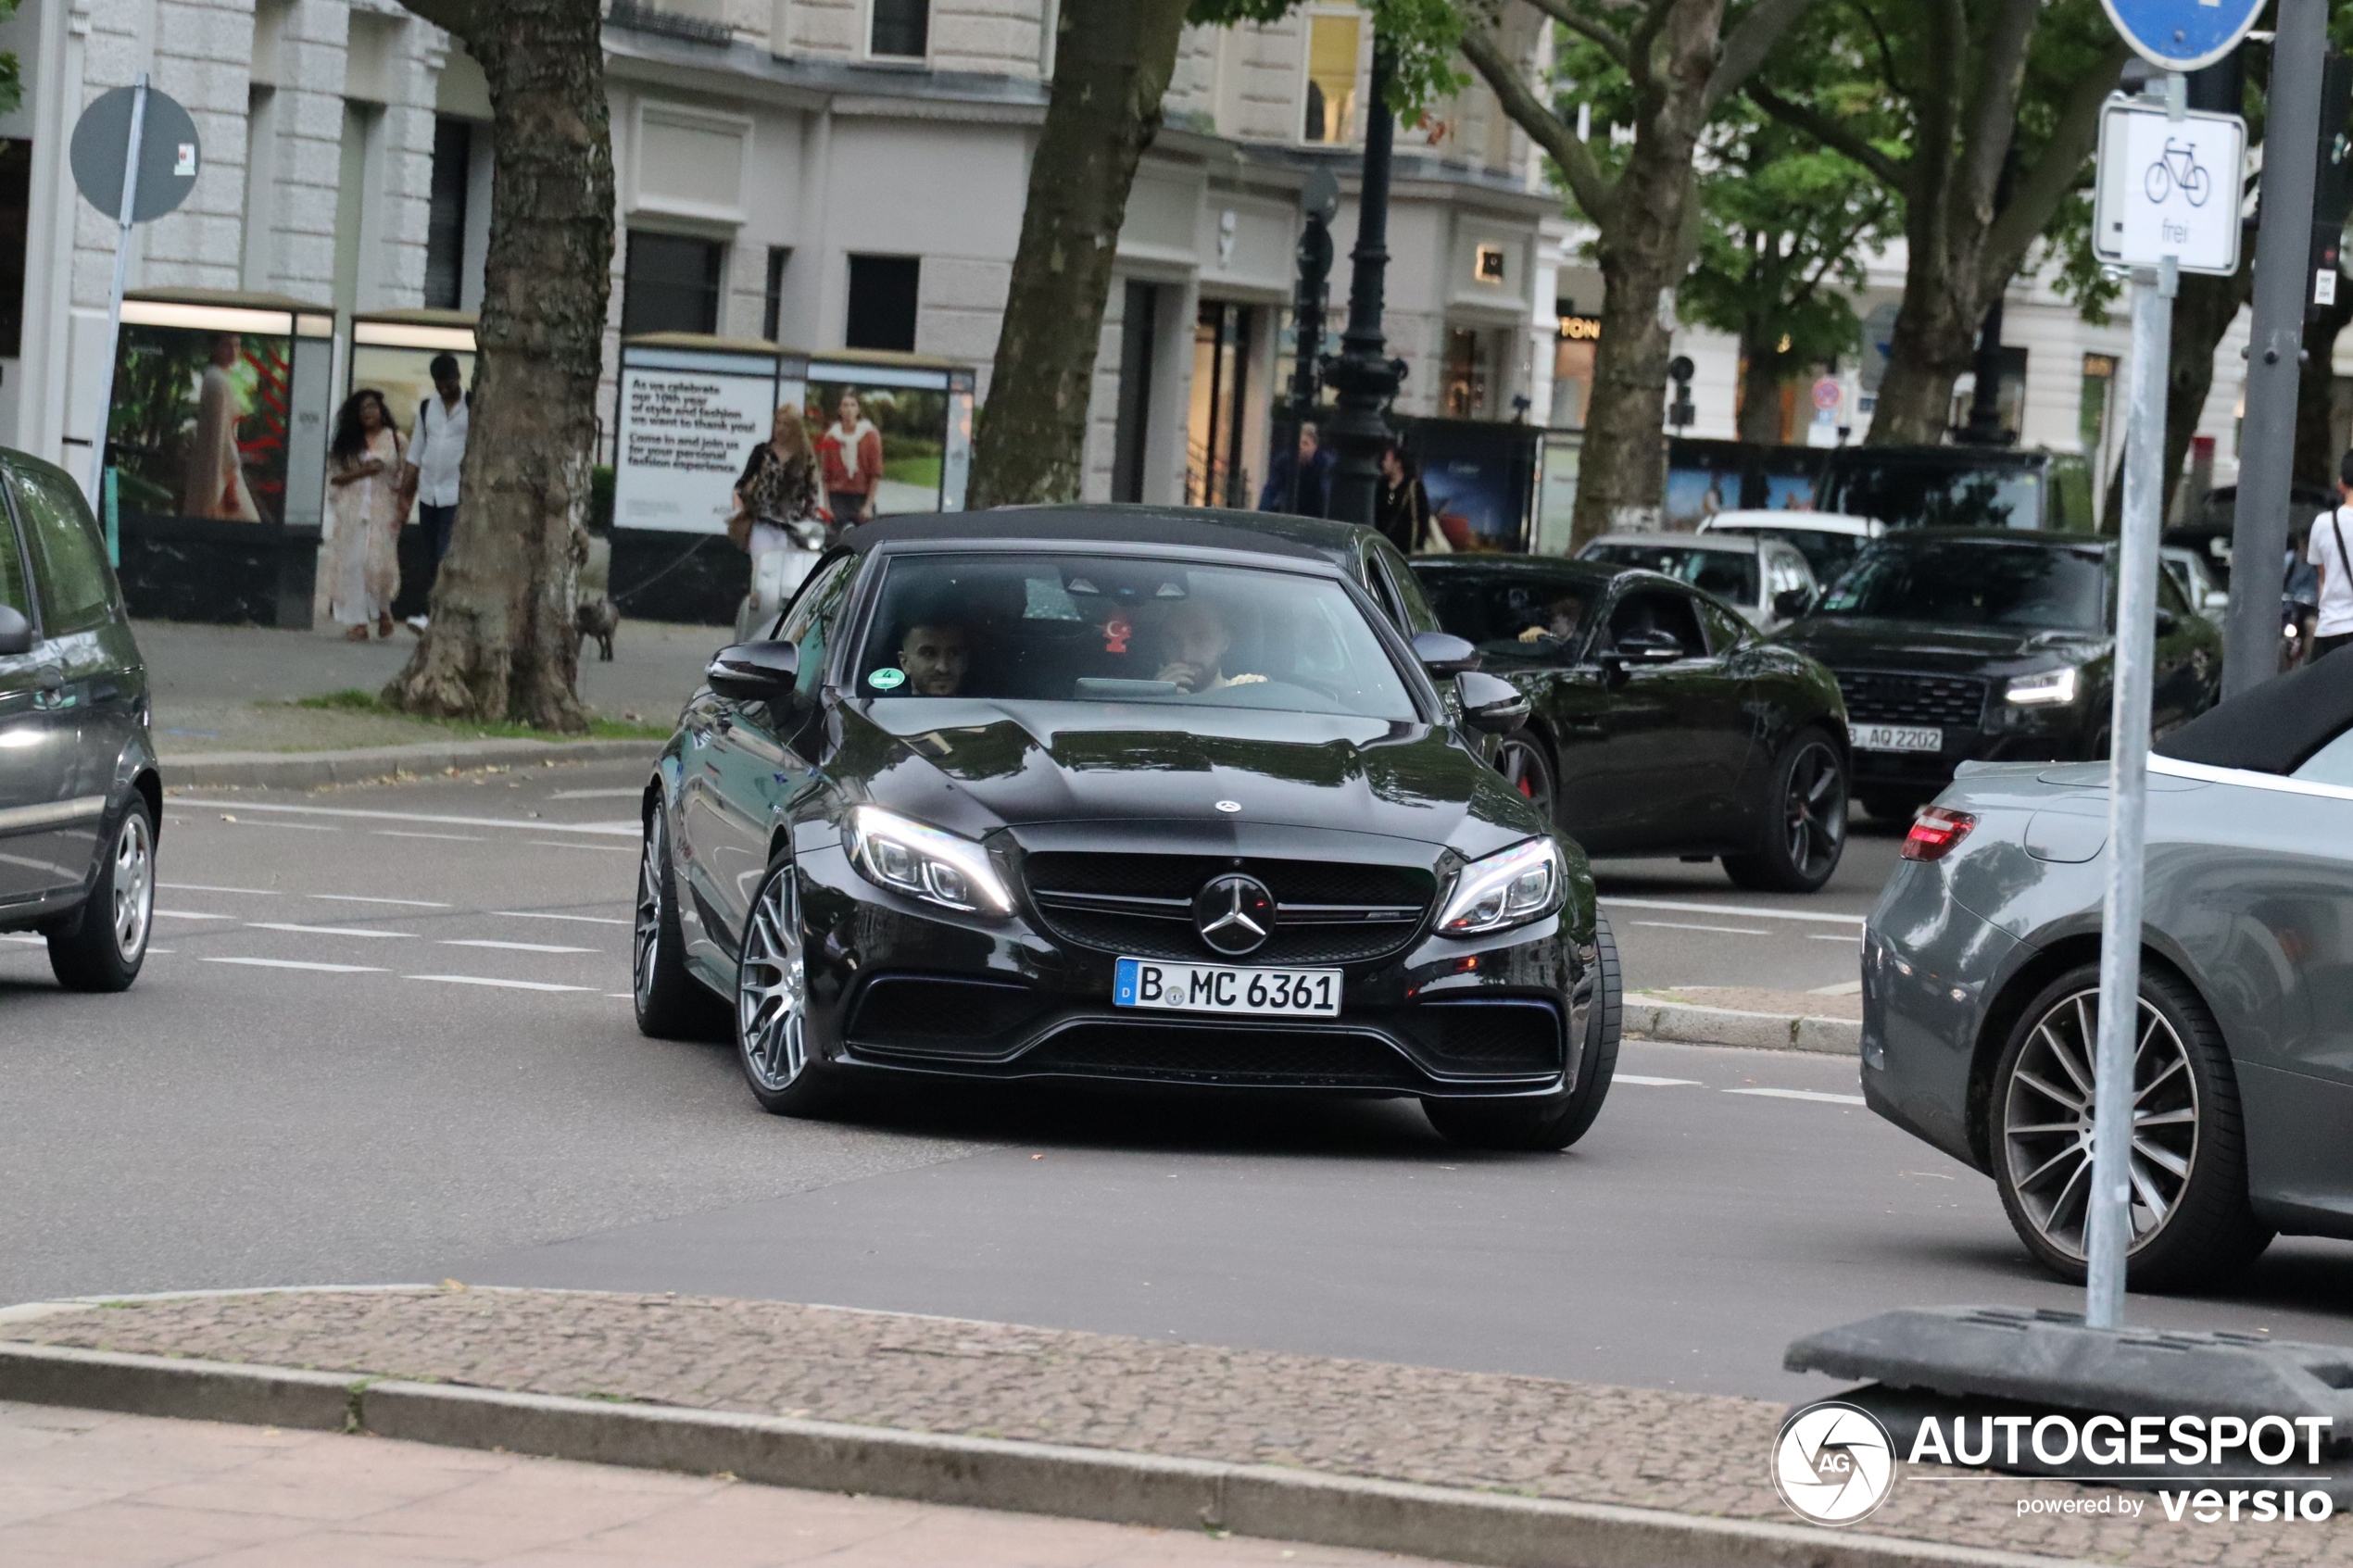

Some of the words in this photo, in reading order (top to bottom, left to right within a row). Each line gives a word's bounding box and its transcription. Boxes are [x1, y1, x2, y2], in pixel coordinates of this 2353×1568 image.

[2162, 218, 2189, 244] frei
[633, 379, 646, 388] As
[668, 383, 720, 394] celebrate
[655, 394, 680, 403] 10th
[684, 398, 707, 407] year
[632, 404, 643, 412] of
[646, 405, 672, 416] style
[675, 407, 696, 415] and
[699, 408, 741, 418] fashion
[680, 419, 691, 428] to
[695, 420, 727, 430] thank
[731, 423, 755, 434] you!
[630, 433, 661, 443] Come
[665, 434, 674, 444] in
[678, 437, 699, 447] and
[702, 438, 724, 450] join
[726, 442, 739, 450] us
[630, 445, 644, 454] for
[648, 448, 673, 457] your
[677, 449, 727, 461] personal
[628, 456, 670, 468] fashion
[673, 462, 738, 474] experience.
[882, 669, 891, 678] 4
[1869, 729, 1892, 746] AQ
[1896, 730, 1939, 749] 2202
[1121, 988, 1131, 998] D
[1140, 966, 1162, 1001] B
[1189, 970, 1237, 1006] MC
[1247, 973, 1334, 1010] 6361
